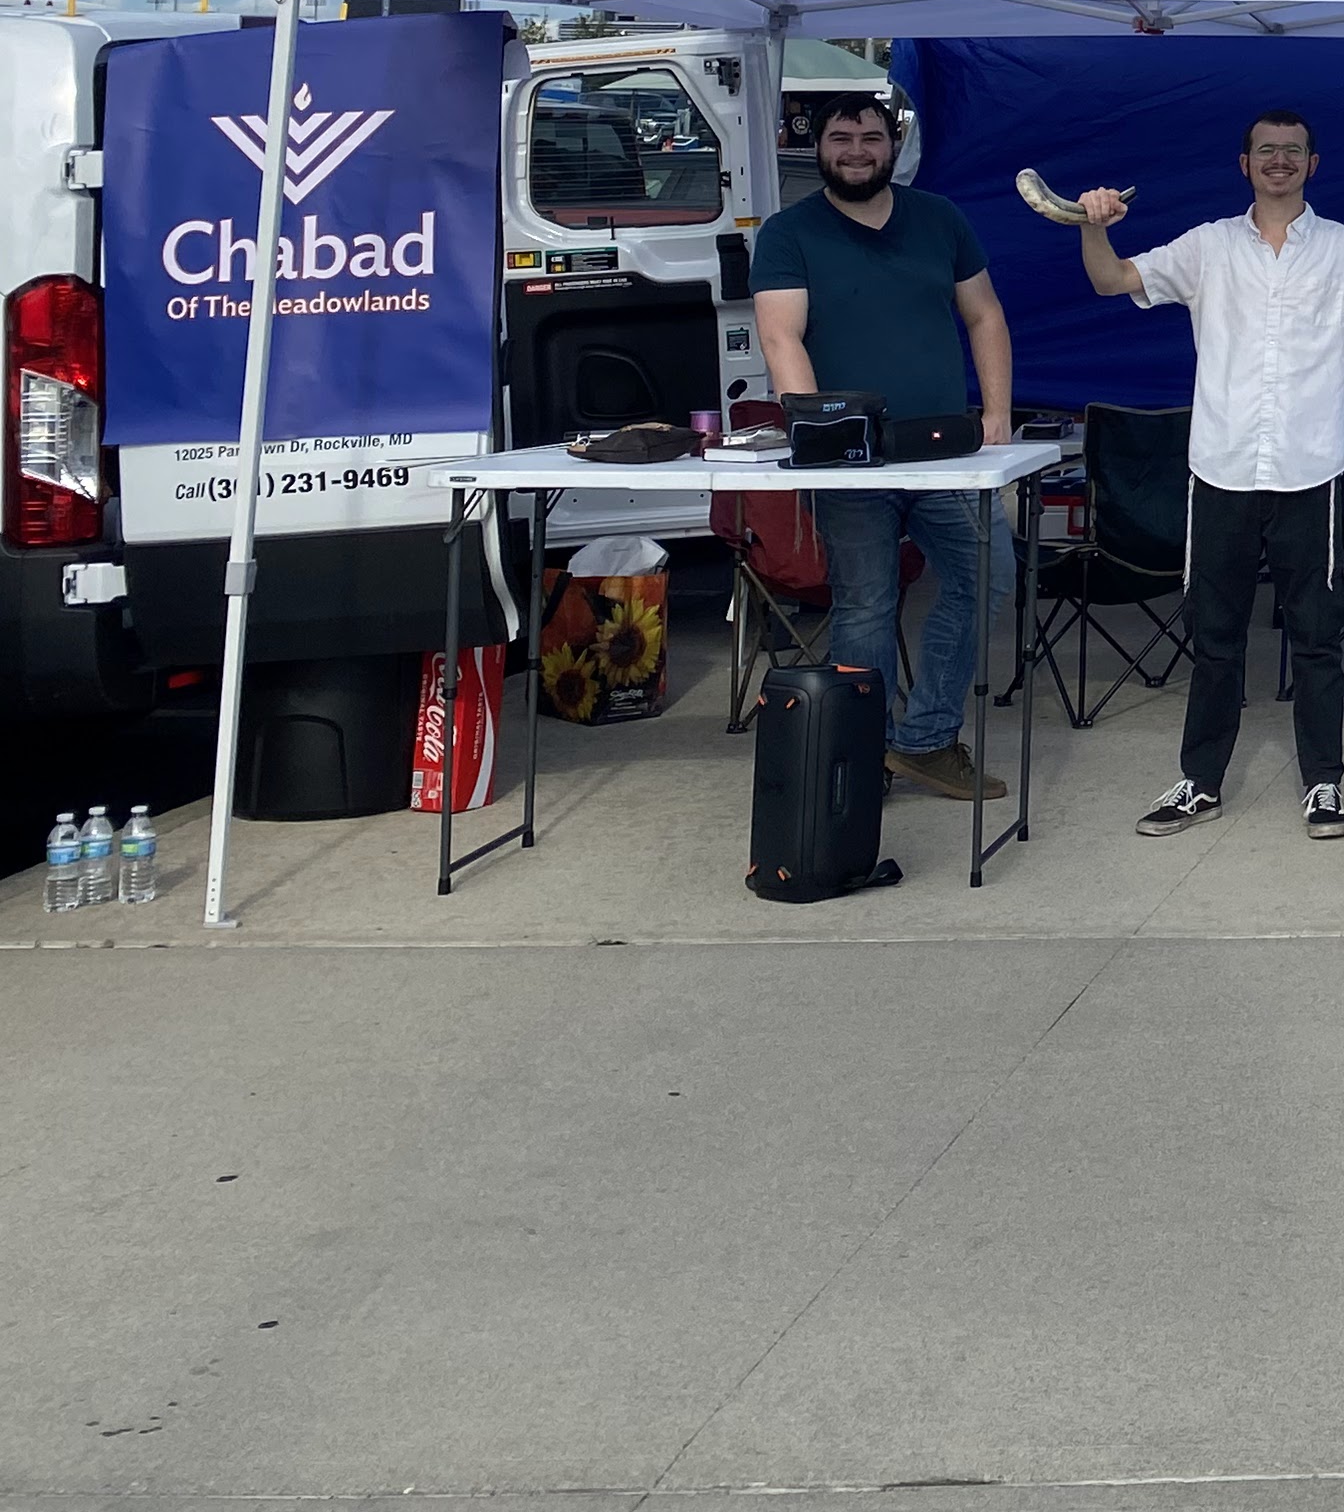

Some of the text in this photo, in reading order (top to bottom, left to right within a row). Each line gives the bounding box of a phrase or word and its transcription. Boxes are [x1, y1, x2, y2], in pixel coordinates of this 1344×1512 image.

[162, 211, 436, 285] Chabad
[167, 288, 430, 319] Of The eadowlands
[174, 447, 214, 462] 12025
[289, 439, 309, 454] Dr,
[313, 433, 385, 452] Rockville,
[388, 432, 413, 446] MD
[174, 482, 205, 500] Call
[280, 465, 410, 494] 231-9469
